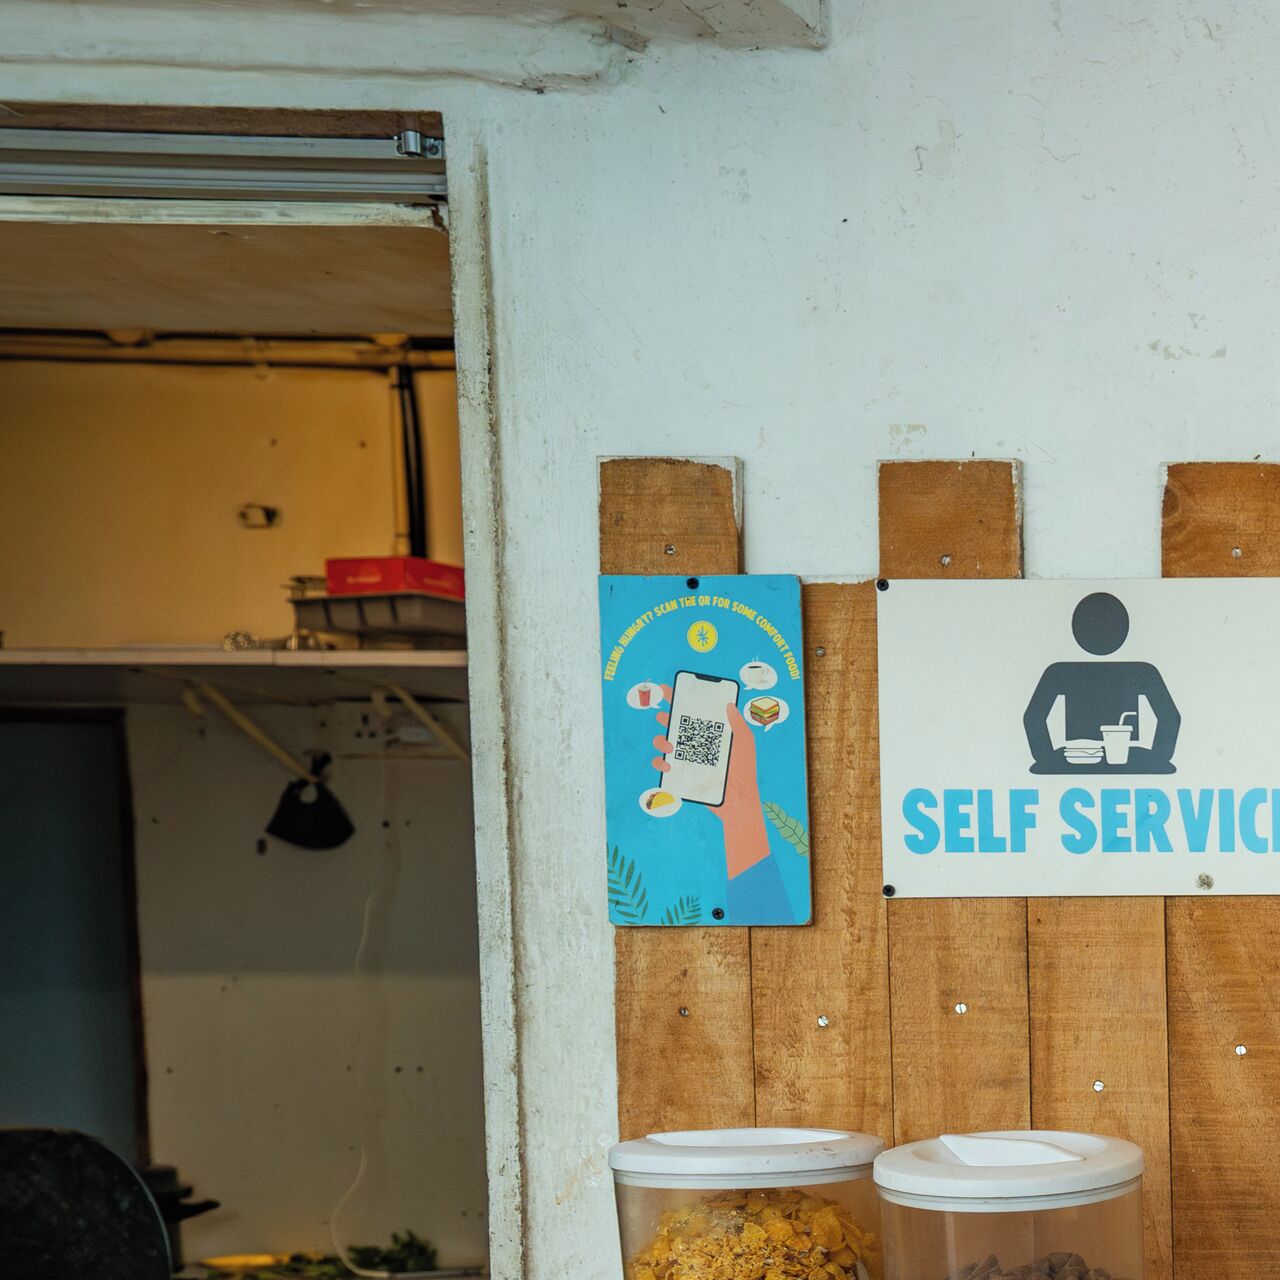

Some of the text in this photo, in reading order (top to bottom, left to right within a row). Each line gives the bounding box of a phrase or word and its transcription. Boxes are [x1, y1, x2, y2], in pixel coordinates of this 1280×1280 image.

[604, 646, 624, 680] FEELING
[618, 611, 653, 647] HUNGRY?
[654, 599, 678, 616] SCAN
[679, 596, 696, 608] THE
[712, 596, 730, 608] FOR
[732, 601, 757, 621] SOME
[756, 615, 789, 652] COMFORT
[784, 651, 800, 680] FOOD!
[902, 788, 1039, 854] SELF
